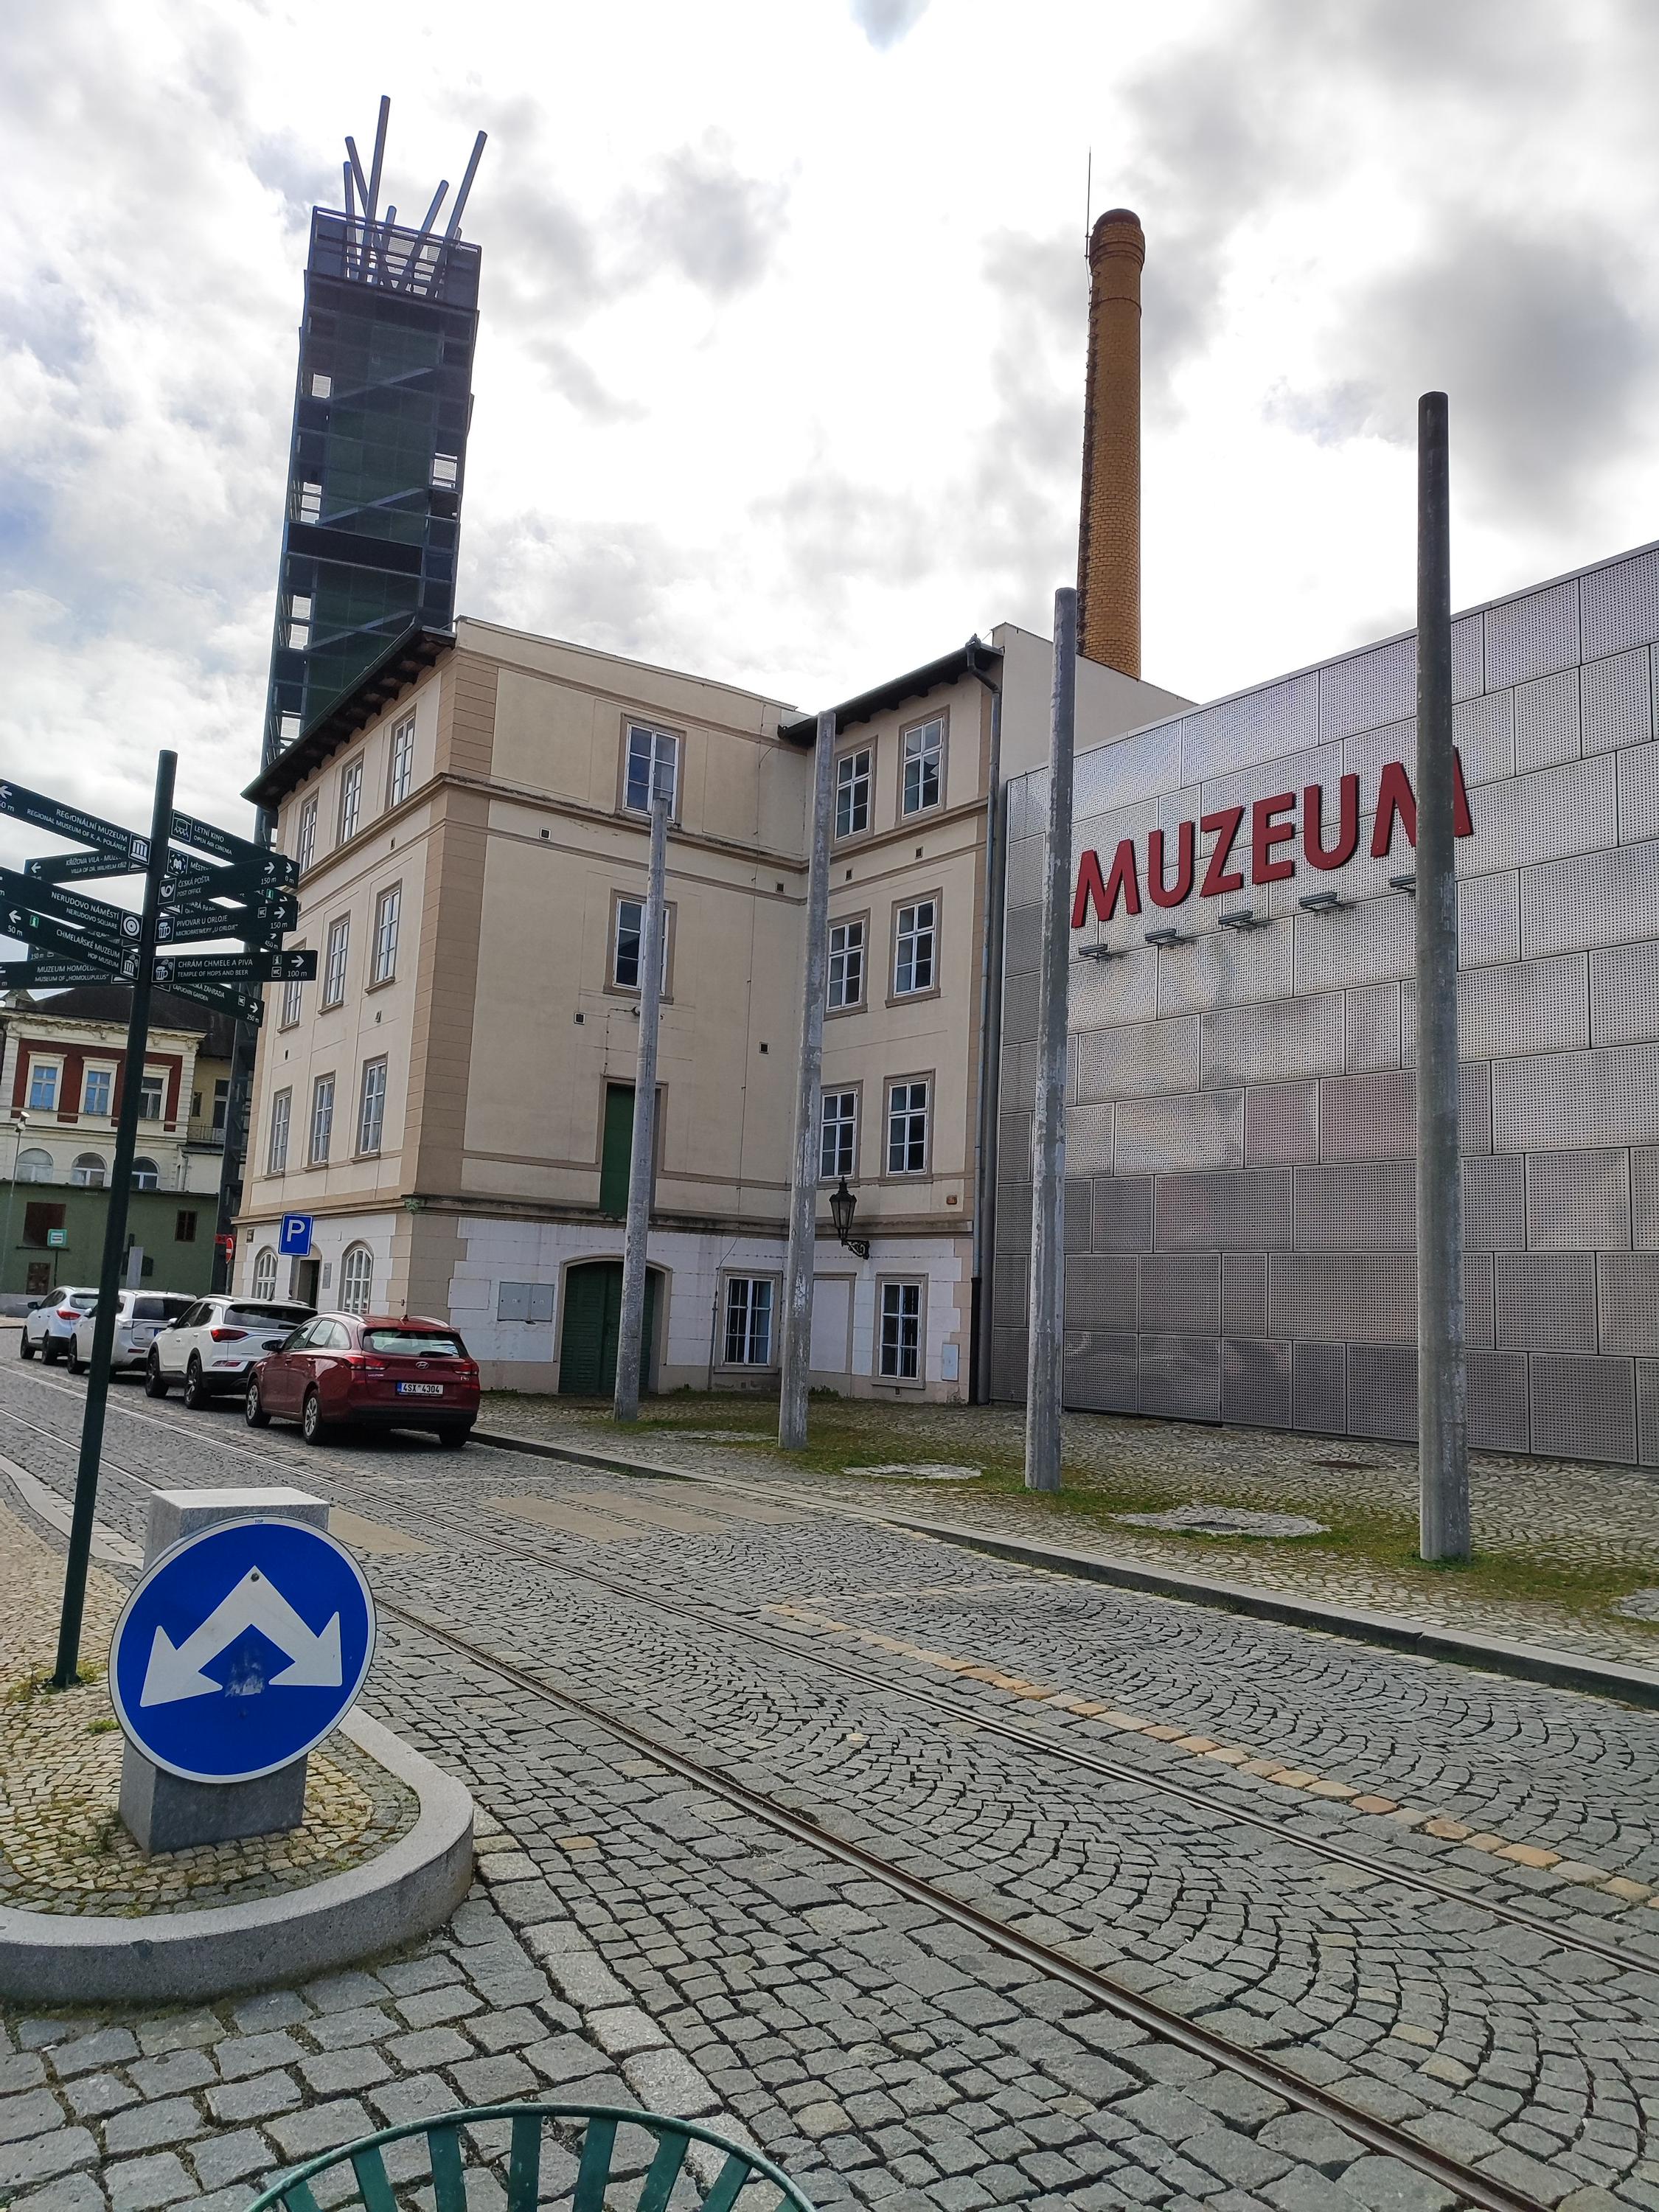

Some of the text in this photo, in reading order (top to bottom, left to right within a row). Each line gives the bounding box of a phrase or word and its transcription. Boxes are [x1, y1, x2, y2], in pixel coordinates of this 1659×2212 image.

[27, 808, 55, 824] REGIONAL
[56, 820, 81, 835] MUSEUM
[103, 836, 127, 852] POLÁNEK
[56, 808, 128, 842] REGIONÁLNÍ MUZEUM
[194, 825, 225, 843] LETNÍ KINO
[1071, 746, 1475, 929] MUZEUM
[193, 835, 232, 855] OPEN AIR CINEMA
[97, 863, 116, 871] WILHELM
[178, 875, 210, 888] ČESKÁ POŠTA
[188, 887, 201, 895] OFFICE
[51, 891, 119, 920] NERUDOVO NÁMĚSTÍ
[66, 908, 118, 930] NERUDOVO SQUARE
[176, 918, 201, 928] PIVOVAR
[206, 915, 228, 924] ORLOJE
[7, 925, 15, 933] 50
[175, 928, 212, 936] MICROBREWERY
[56, 928, 94, 949] CHMELAŘSKÉ
[94, 943, 120, 959] MUZEUM
[88, 952, 119, 968] HOP MUSEUM
[178, 959, 203, 968] CHRÁM
[37, 964, 66, 973] MUZEUM
[173, 984, 192, 995] CAPUCHIN
[193, 991, 209, 1001] GARDEN
[204, 984, 225, 998] ZAHRADA
[287, 1220, 305, 1242] P
[403, 1384, 439, 1393] 4SX 4304
